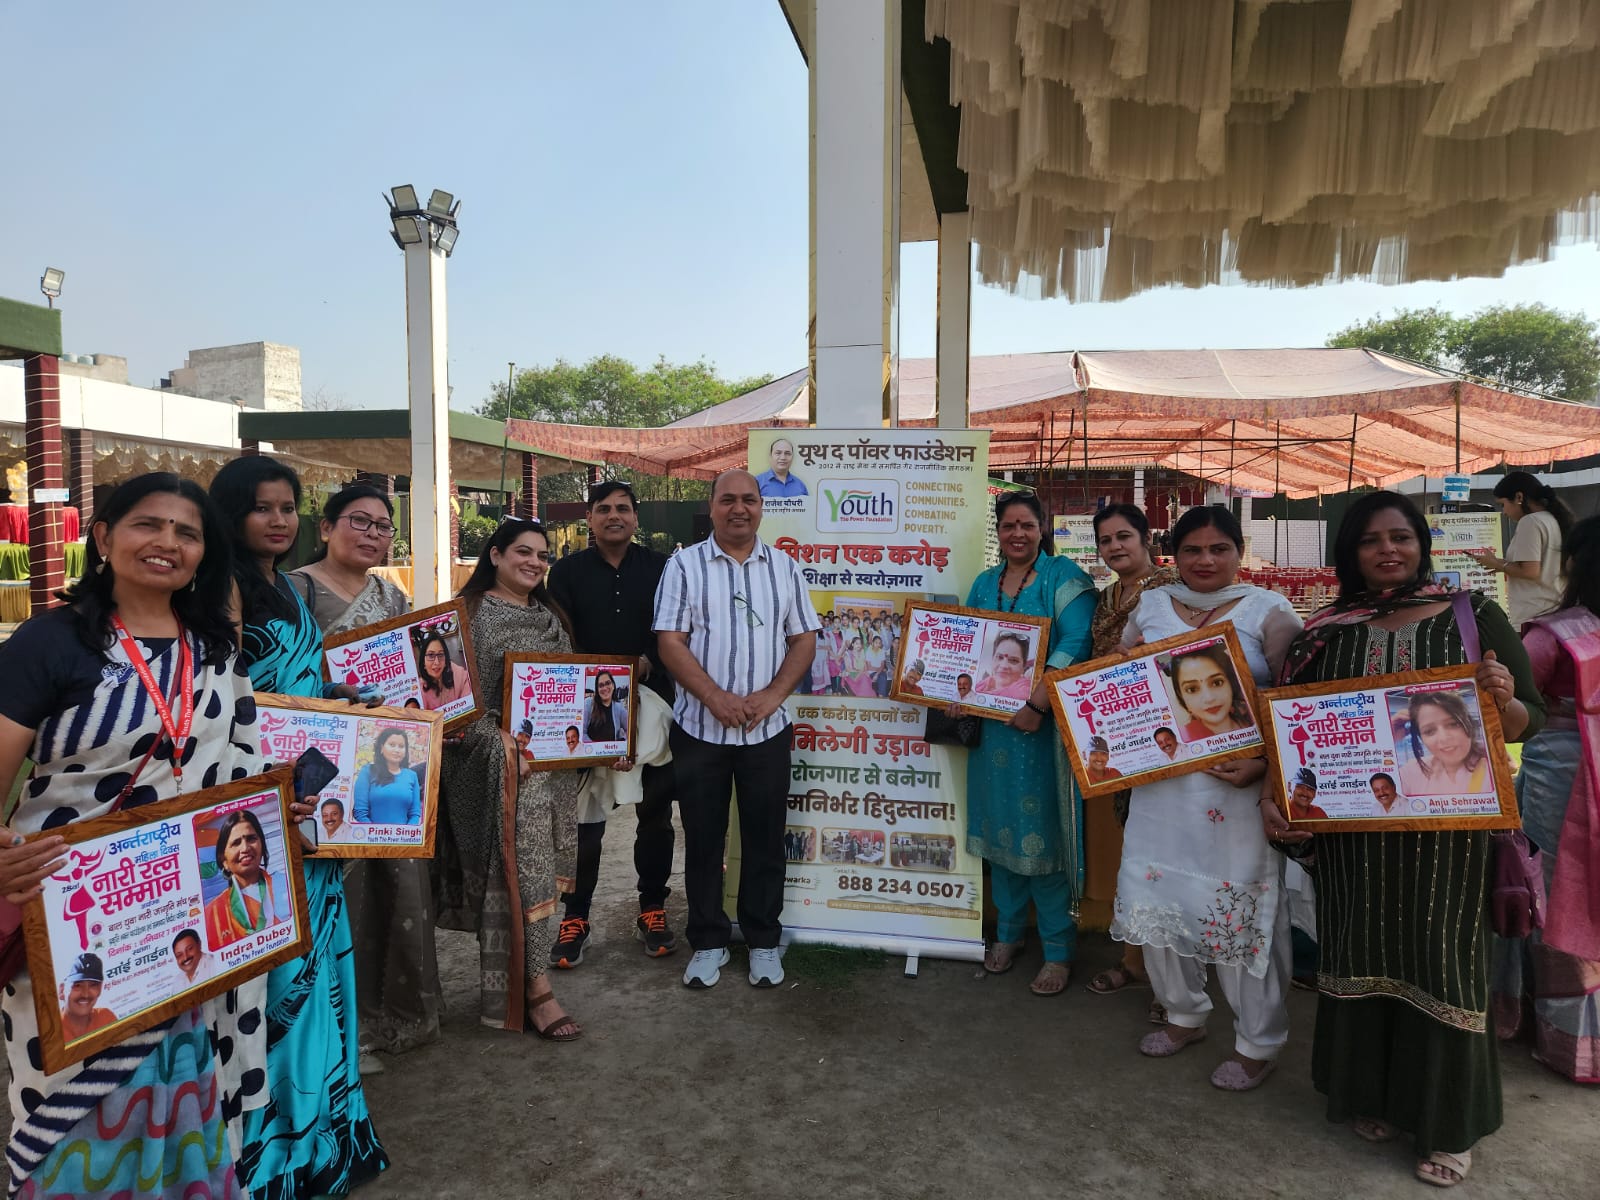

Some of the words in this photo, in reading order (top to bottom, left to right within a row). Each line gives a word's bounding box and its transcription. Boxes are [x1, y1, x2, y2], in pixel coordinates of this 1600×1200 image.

[798, 444, 827, 466] यूथ
[831, 444, 844, 462] द
[847, 438, 889, 461] पॉवर
[893, 439, 977, 462] फाउंडेशन
[906, 481, 963, 493] CONNECTING
[824, 489, 893, 522] Youth
[905, 495, 968, 508] COMMUNITIES,
[904, 509, 956, 521] COMBATING
[904, 523, 948, 535] POVERTY.
[775, 536, 839, 564] मिशन
[842, 544, 883, 565] एक
[886, 538, 951, 573] करोड़
[802, 568, 837, 586] शिक्षा
[839, 569, 852, 585] से
[855, 569, 923, 589] स्वरोज़गार
[930, 626, 952, 640] नारी
[952, 632, 974, 643] रत्न
[931, 638, 974, 654] सम्मान
[356, 653, 381, 674] नारी
[381, 650, 404, 666] रत्न
[361, 661, 406, 685] सम्मान
[535, 677, 555, 693] नारी
[556, 682, 576, 693] रत्न
[1090, 682, 1120, 703] नारी
[1120, 680, 1150, 696] रत्न
[442, 700, 467, 713] Kanchan
[536, 692, 577, 704] सम्मान
[1097, 691, 1154, 717] सम्मान
[796, 706, 819, 721] एक
[821, 704, 857, 725] करोड़
[859, 706, 898, 723] सपनों
[900, 708, 921, 724] को
[1306, 712, 1339, 733] नारी
[1340, 715, 1375, 731] रत्न
[181, 719, 191, 736] Youth
[1206, 736, 1227, 747] Pinki
[1228, 728, 1258, 742] Kumari
[1311, 728, 1377, 749] सम्मान
[272, 729, 307, 750] नारी
[309, 739, 344, 753] रत्न
[790, 723, 870, 753] मिलेगी
[873, 733, 931, 762] उड़ान
[791, 759, 861, 783] रोजगार
[862, 762, 882, 785] से
[885, 763, 942, 788] बनेगा
[786, 788, 860, 815] मनिर्भर
[862, 791, 956, 826] हिंदुस्तान!
[1428, 798, 1449, 809] Anju
[1451, 797, 1497, 807] Sehrawat
[368, 826, 393, 837] Pinki
[395, 827, 422, 838] Singh
[133, 848, 158, 864] महिला
[159, 843, 180, 857] दिवस
[91, 856, 136, 893] नारी
[137, 852, 180, 880] रत्न
[98, 870, 182, 915] सम्मान
[838, 875, 873, 892] 888
[877, 877, 912, 895] 234
[916, 880, 965, 899] 0507
[108, 920, 123, 932] बाल
[124, 916, 138, 930] युवा
[138, 908, 152, 921] नारी
[153, 900, 176, 917] जागृति
[107, 942, 131, 957] दिनांक
[139, 931, 165, 946] शनिवार
[171, 921, 185, 933] मार्च
[220, 940, 254, 962] Indra
[256, 924, 293, 947] Dubey
[105, 956, 131, 979] सांई
[135, 945, 169, 967] गार्डन
[228, 956, 242, 968] Youth
[242, 952, 251, 962] The
[251, 945, 266, 957] Power
[265, 936, 290, 952] Foundation
